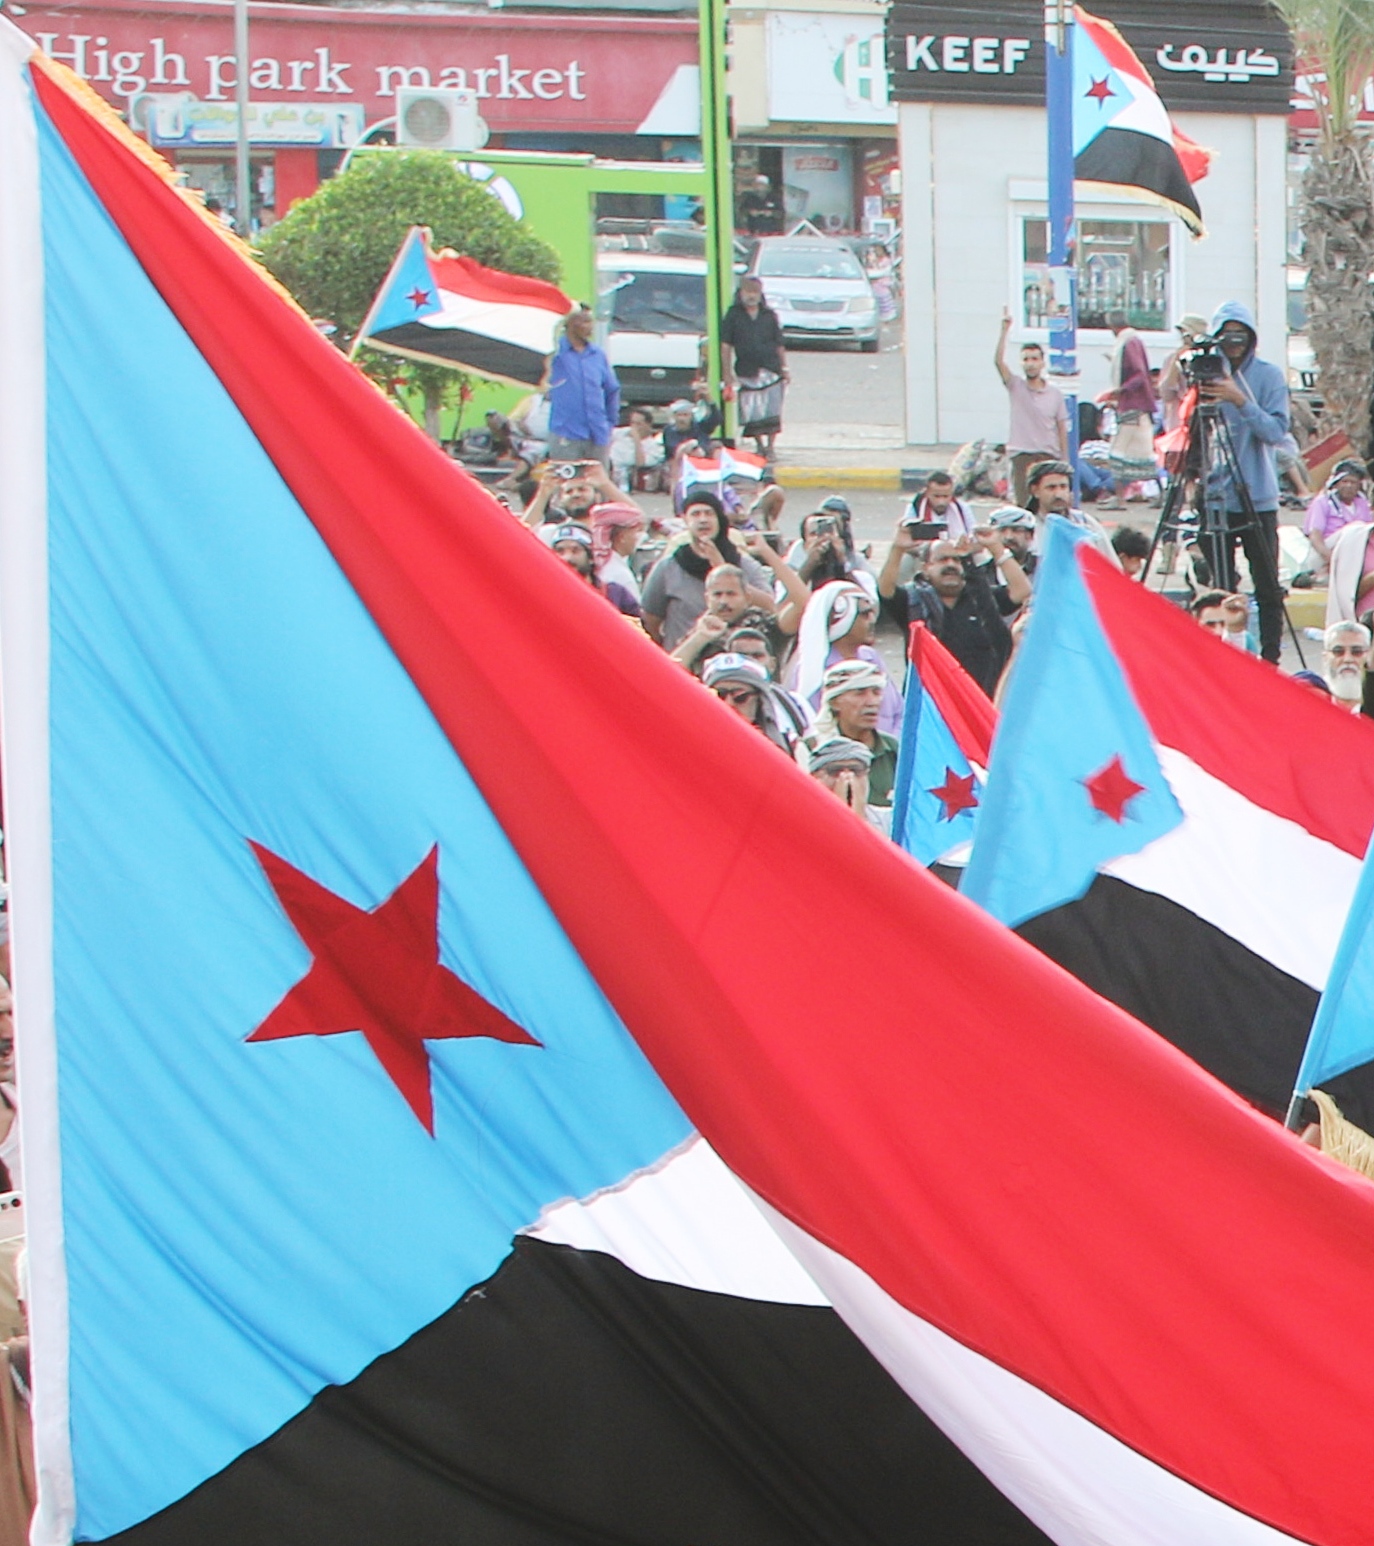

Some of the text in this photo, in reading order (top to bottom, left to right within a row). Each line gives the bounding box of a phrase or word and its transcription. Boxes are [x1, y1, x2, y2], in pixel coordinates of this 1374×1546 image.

[36, 32, 587, 101] High park market
[905, 35, 1031, 74] KEEF
[1156, 43, 1280, 83] كييف
